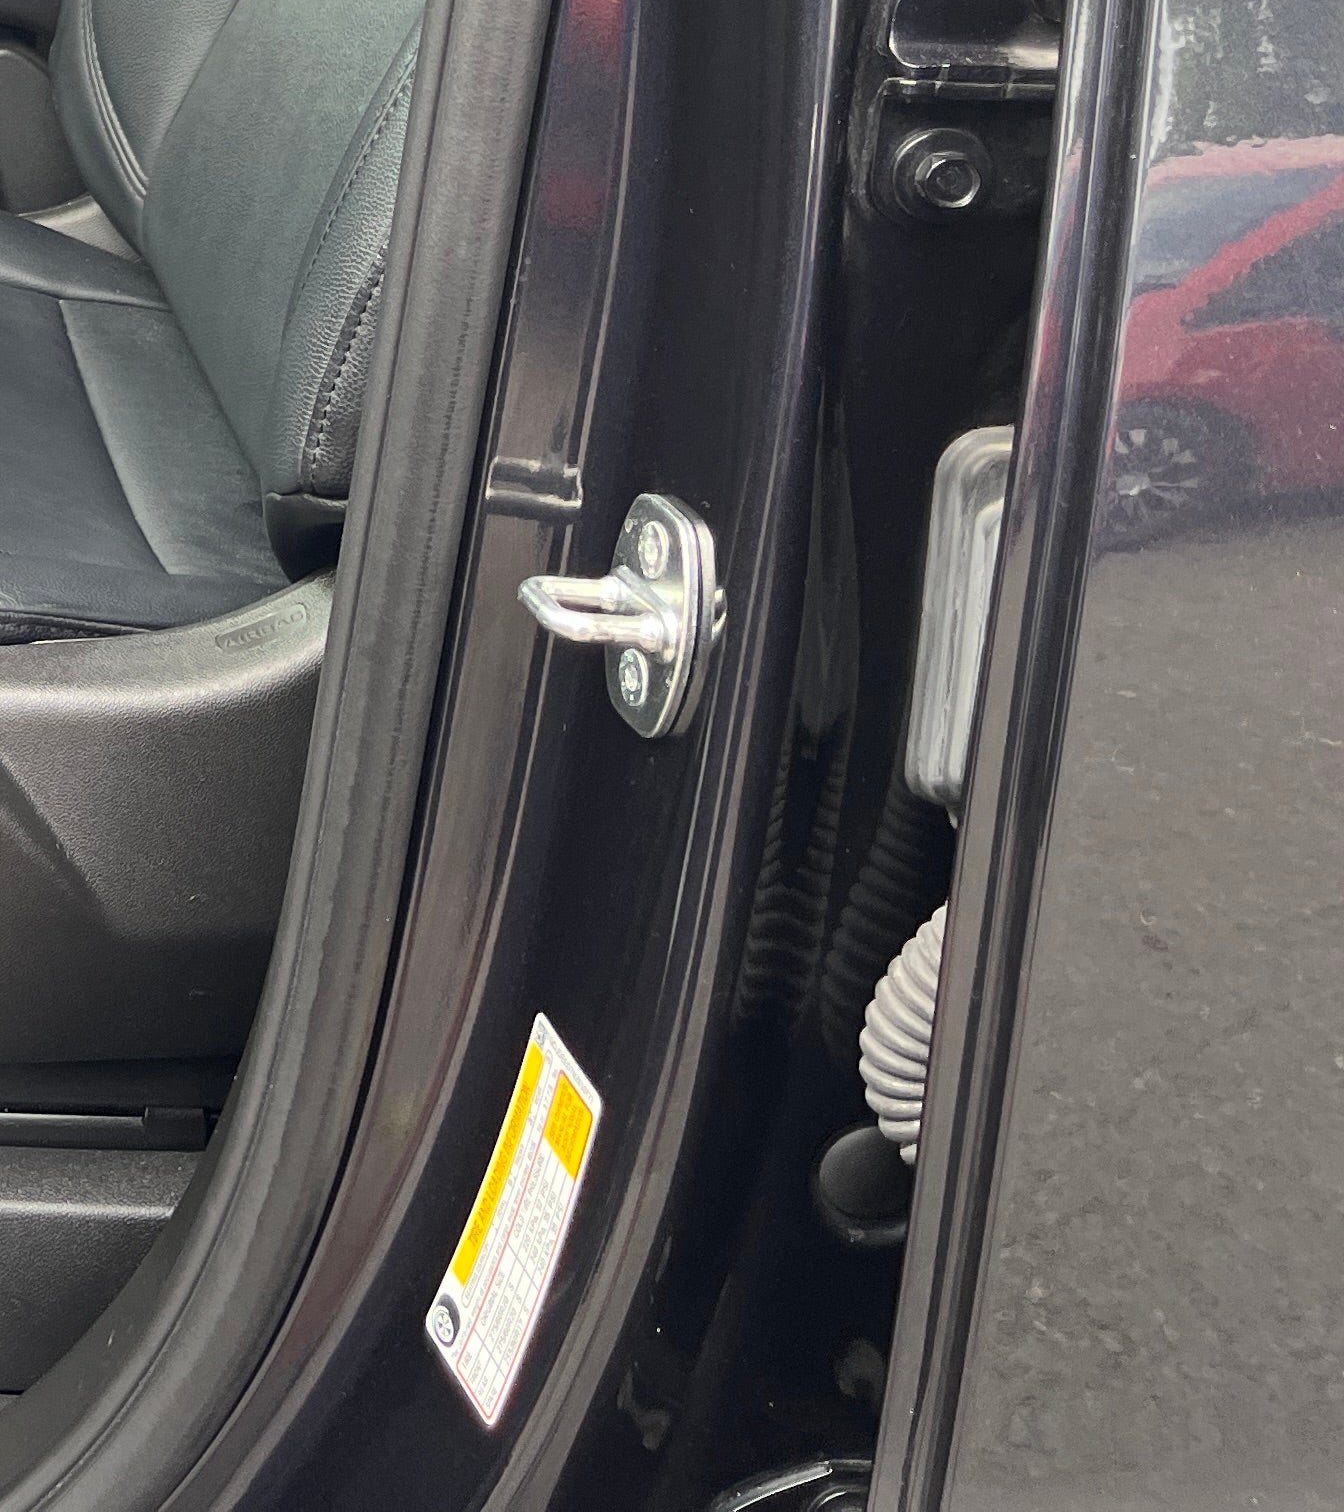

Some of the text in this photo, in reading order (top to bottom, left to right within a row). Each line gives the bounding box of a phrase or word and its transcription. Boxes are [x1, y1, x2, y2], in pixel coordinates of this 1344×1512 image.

[467, 1218, 483, 1250] TIRE
[476, 1194, 491, 1227] AND
[485, 1149, 508, 1203] LOADING
[501, 1078, 531, 1156] INFORMATION
